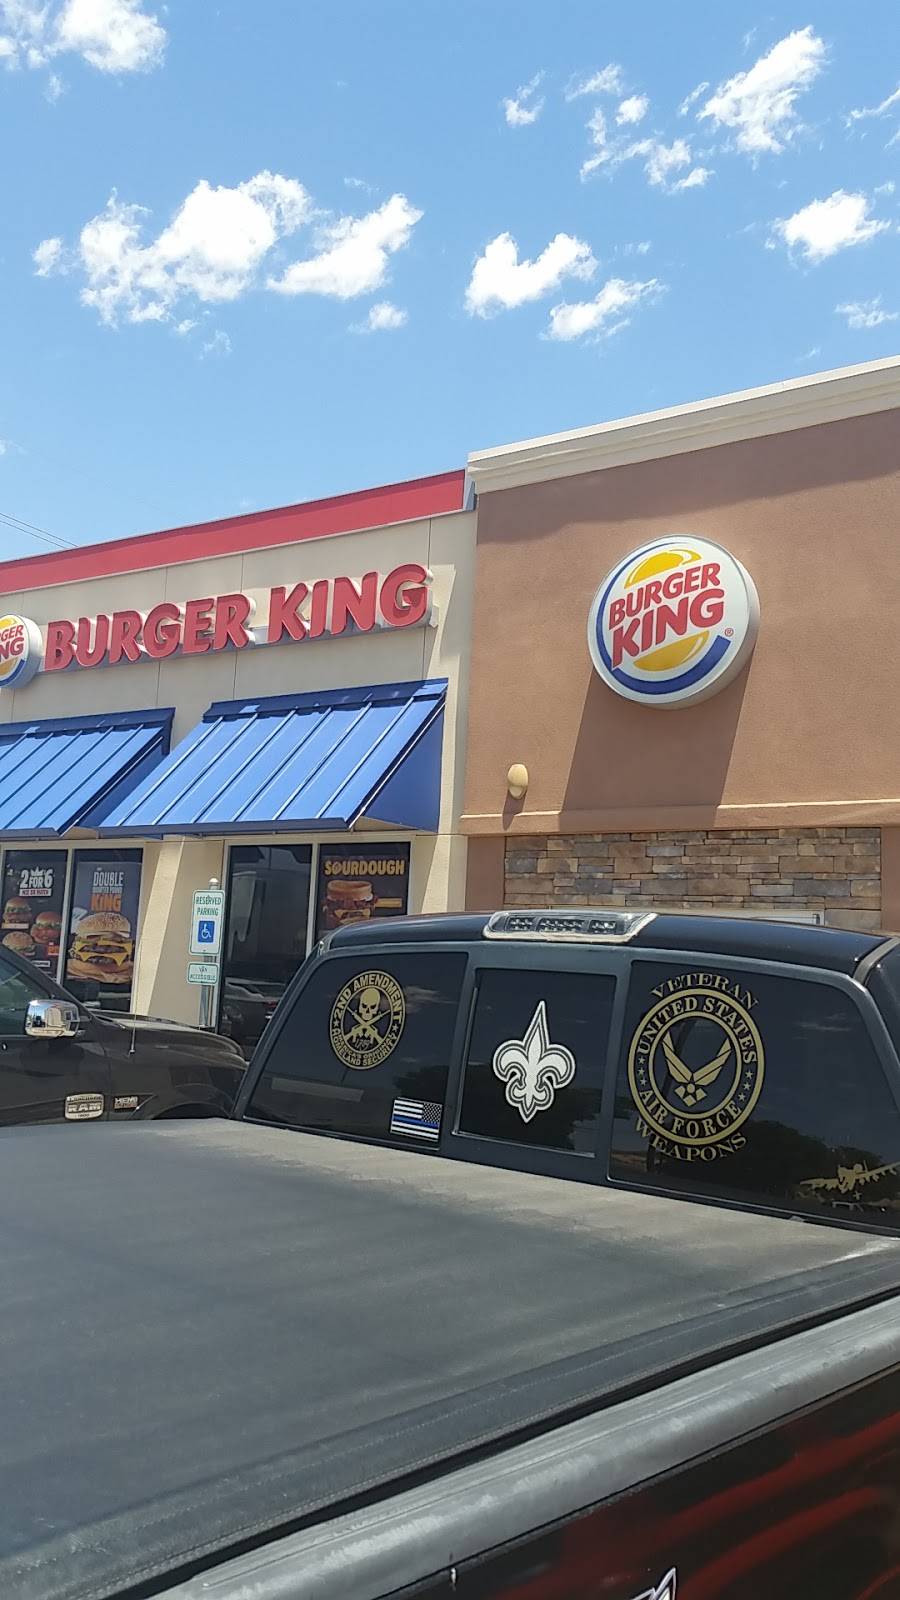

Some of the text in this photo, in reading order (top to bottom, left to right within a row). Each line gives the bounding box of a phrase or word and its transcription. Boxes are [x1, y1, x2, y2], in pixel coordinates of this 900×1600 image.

[609, 563, 720, 630] BURGER
[44, 564, 429, 672] BURGER KING
[613, 588, 724, 669] KING
[20, 868, 53, 888] 2 FOR 6
[93, 871, 124, 887] DOUBLE
[324, 859, 405, 875] SOURDOUGH
[91, 893, 122, 912] KING
[196, 896, 222, 905] RESERVED
[196, 907, 219, 916] PARKING
[334, 974, 402, 1023] 2ND AMENDMENT
[651, 972, 759, 1011] VETERAN
[331, 1028, 398, 1067] HOMELAND SECURITY
[637, 996, 758, 1064] UNITED STATES
[68, 1102, 102, 1112] RAM
[114, 1096, 138, 1104] HEMI
[639, 1088, 742, 1139] AIR FORCE
[635, 1116, 748, 1162] WEAPONS
